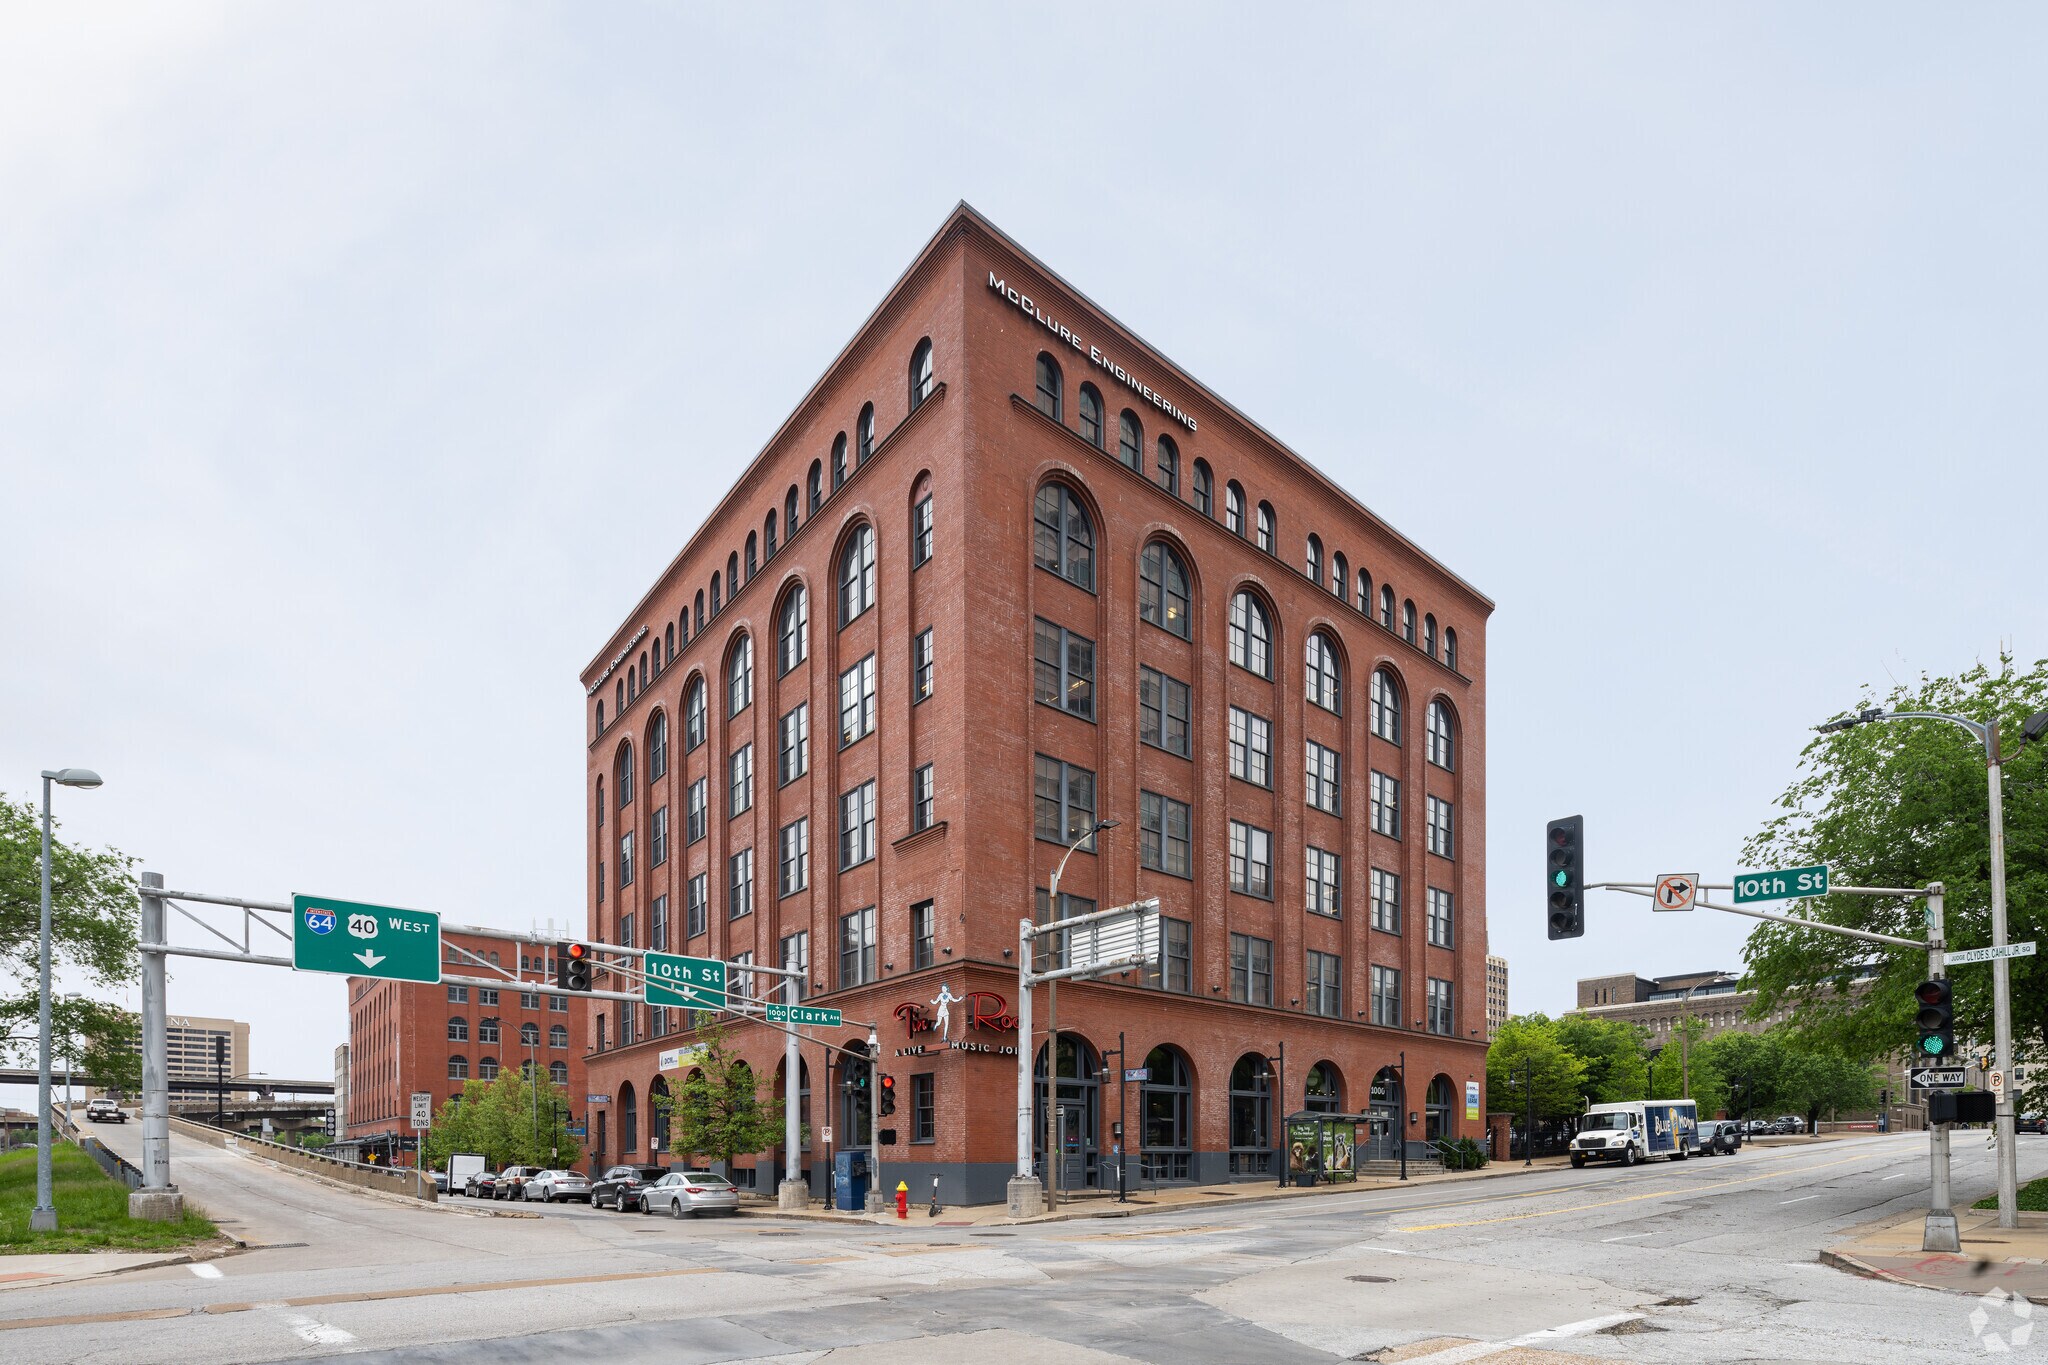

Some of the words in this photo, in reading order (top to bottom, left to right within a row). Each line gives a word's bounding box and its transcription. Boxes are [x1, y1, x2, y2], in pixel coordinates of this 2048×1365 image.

[1090, 345, 1198, 432] ENGINEERING
[1738, 878, 1786, 897] 10th
[1797, 872, 1823, 891] St
[308, 915, 333, 930] 64
[351, 919, 375, 934] 40
[389, 917, 430, 933] WEST
[1966, 950, 1984, 961] CLYDE
[651, 962, 692, 980] 10th
[702, 968, 720, 983] St
[768, 1009, 786, 1017] 1000
[790, 1009, 828, 1021] Clark
[903, 1045, 922, 1056] LIVE
[951, 1042, 990, 1052] MUSIC
[999, 1046, 1019, 1055] JOI
[1920, 1073, 1940, 1083] ONE
[1942, 1072, 1962, 1082] WAY
[1655, 1115, 1671, 1136] BLUE
[1679, 1115, 1695, 1130] MOON
